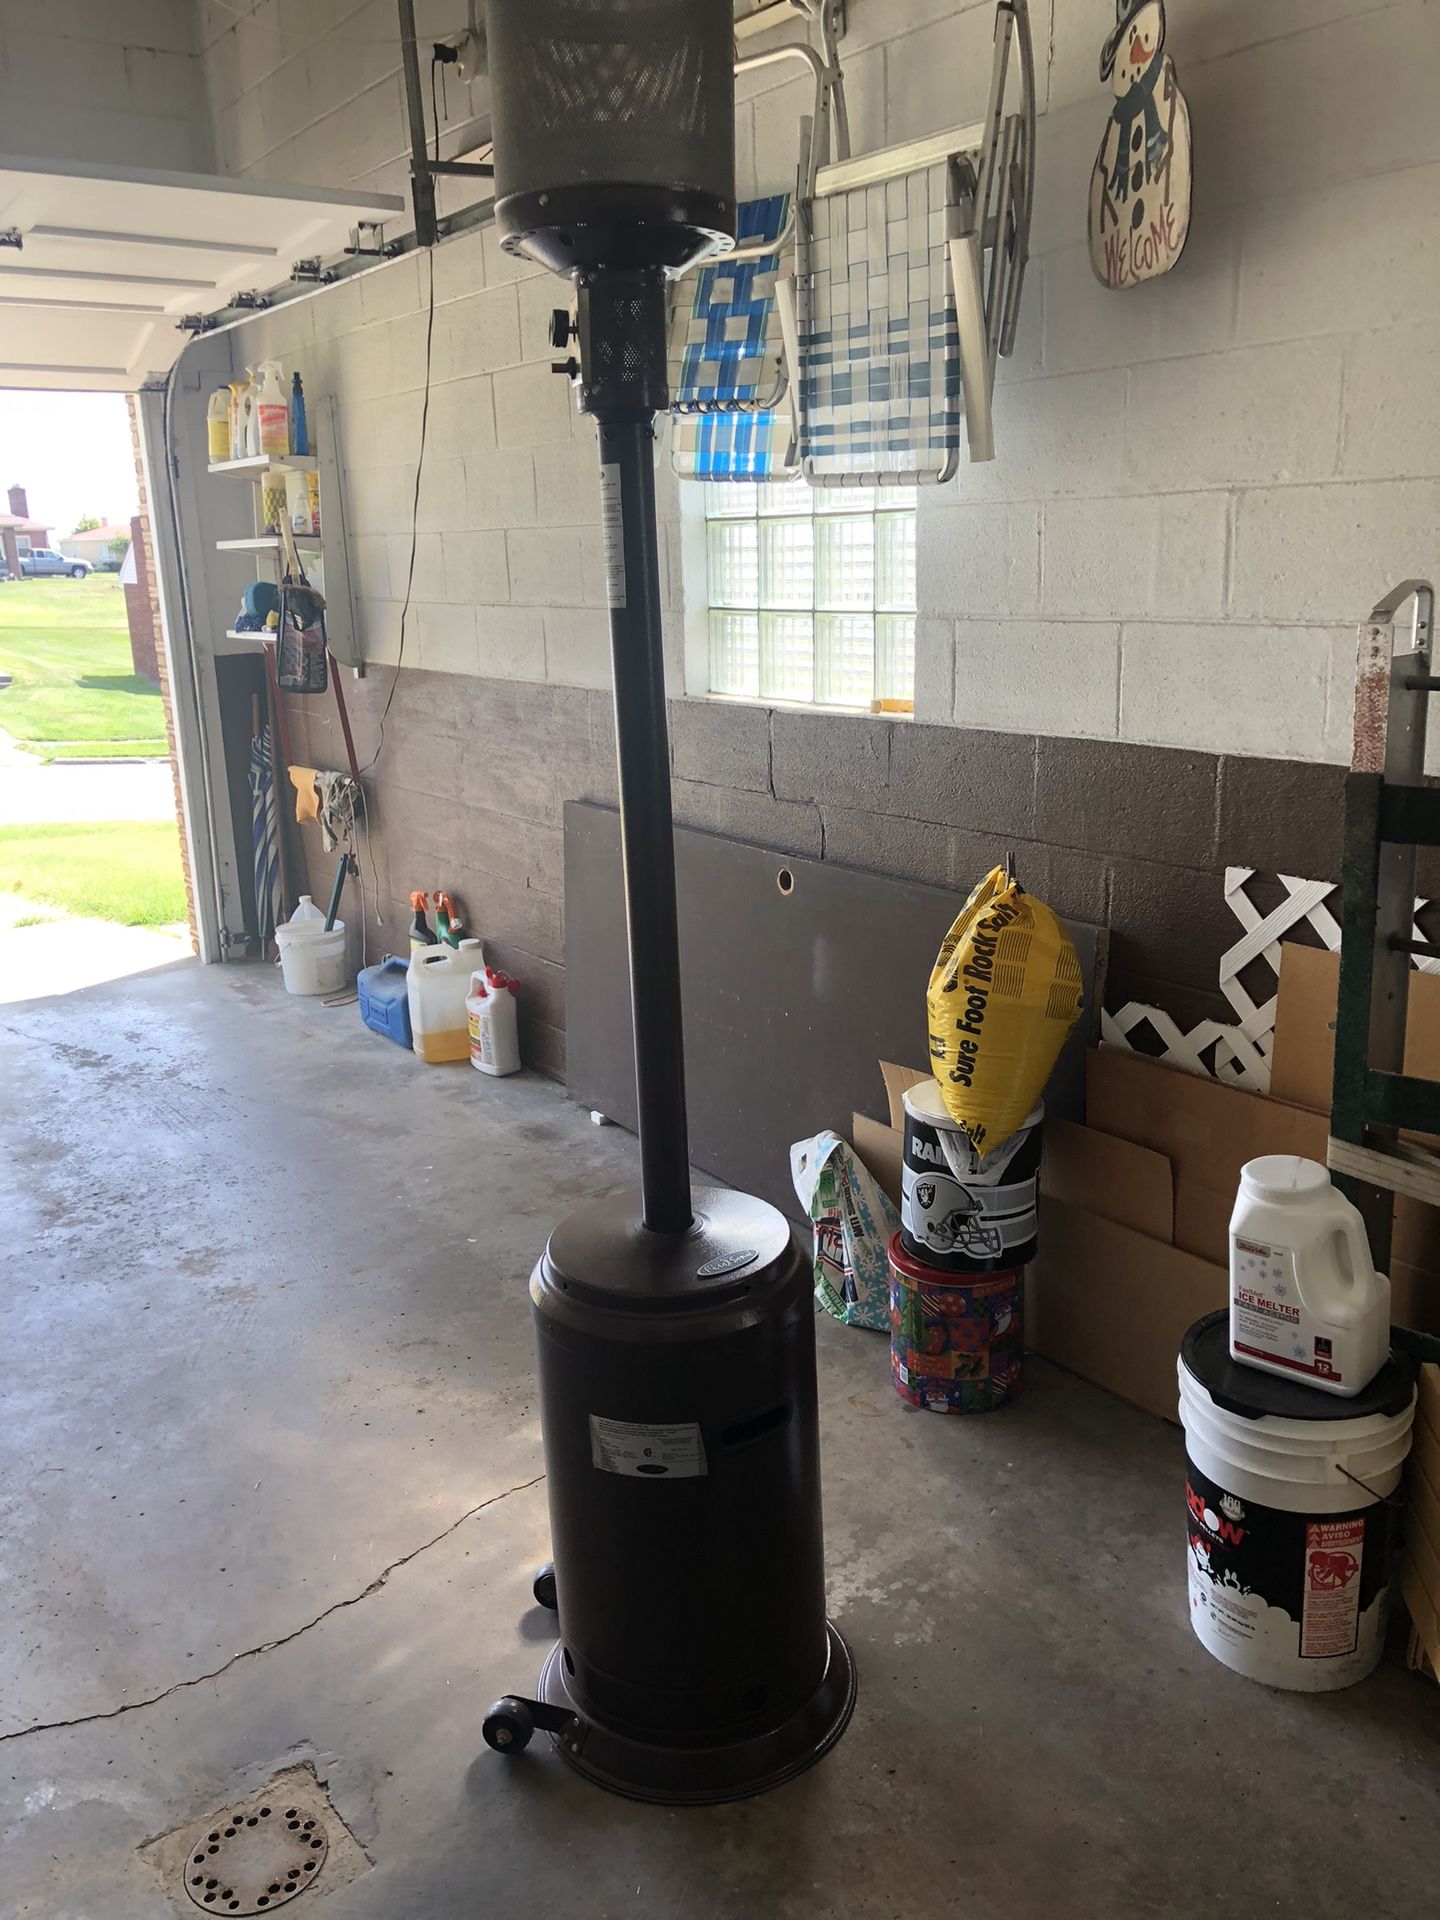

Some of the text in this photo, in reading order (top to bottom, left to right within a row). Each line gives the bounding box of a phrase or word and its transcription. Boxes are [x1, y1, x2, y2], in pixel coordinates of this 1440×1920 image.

[1104, 203, 1181, 284] WELCOME
[950, 901, 1019, 1087] Sure Foot Rock Salt
[1238, 1292, 1300, 1317] ICE MELTER
[1317, 1363, 1329, 1372] 12
[1320, 1519, 1364, 1533] WARNING
[1321, 1530, 1350, 1540] AVISO
